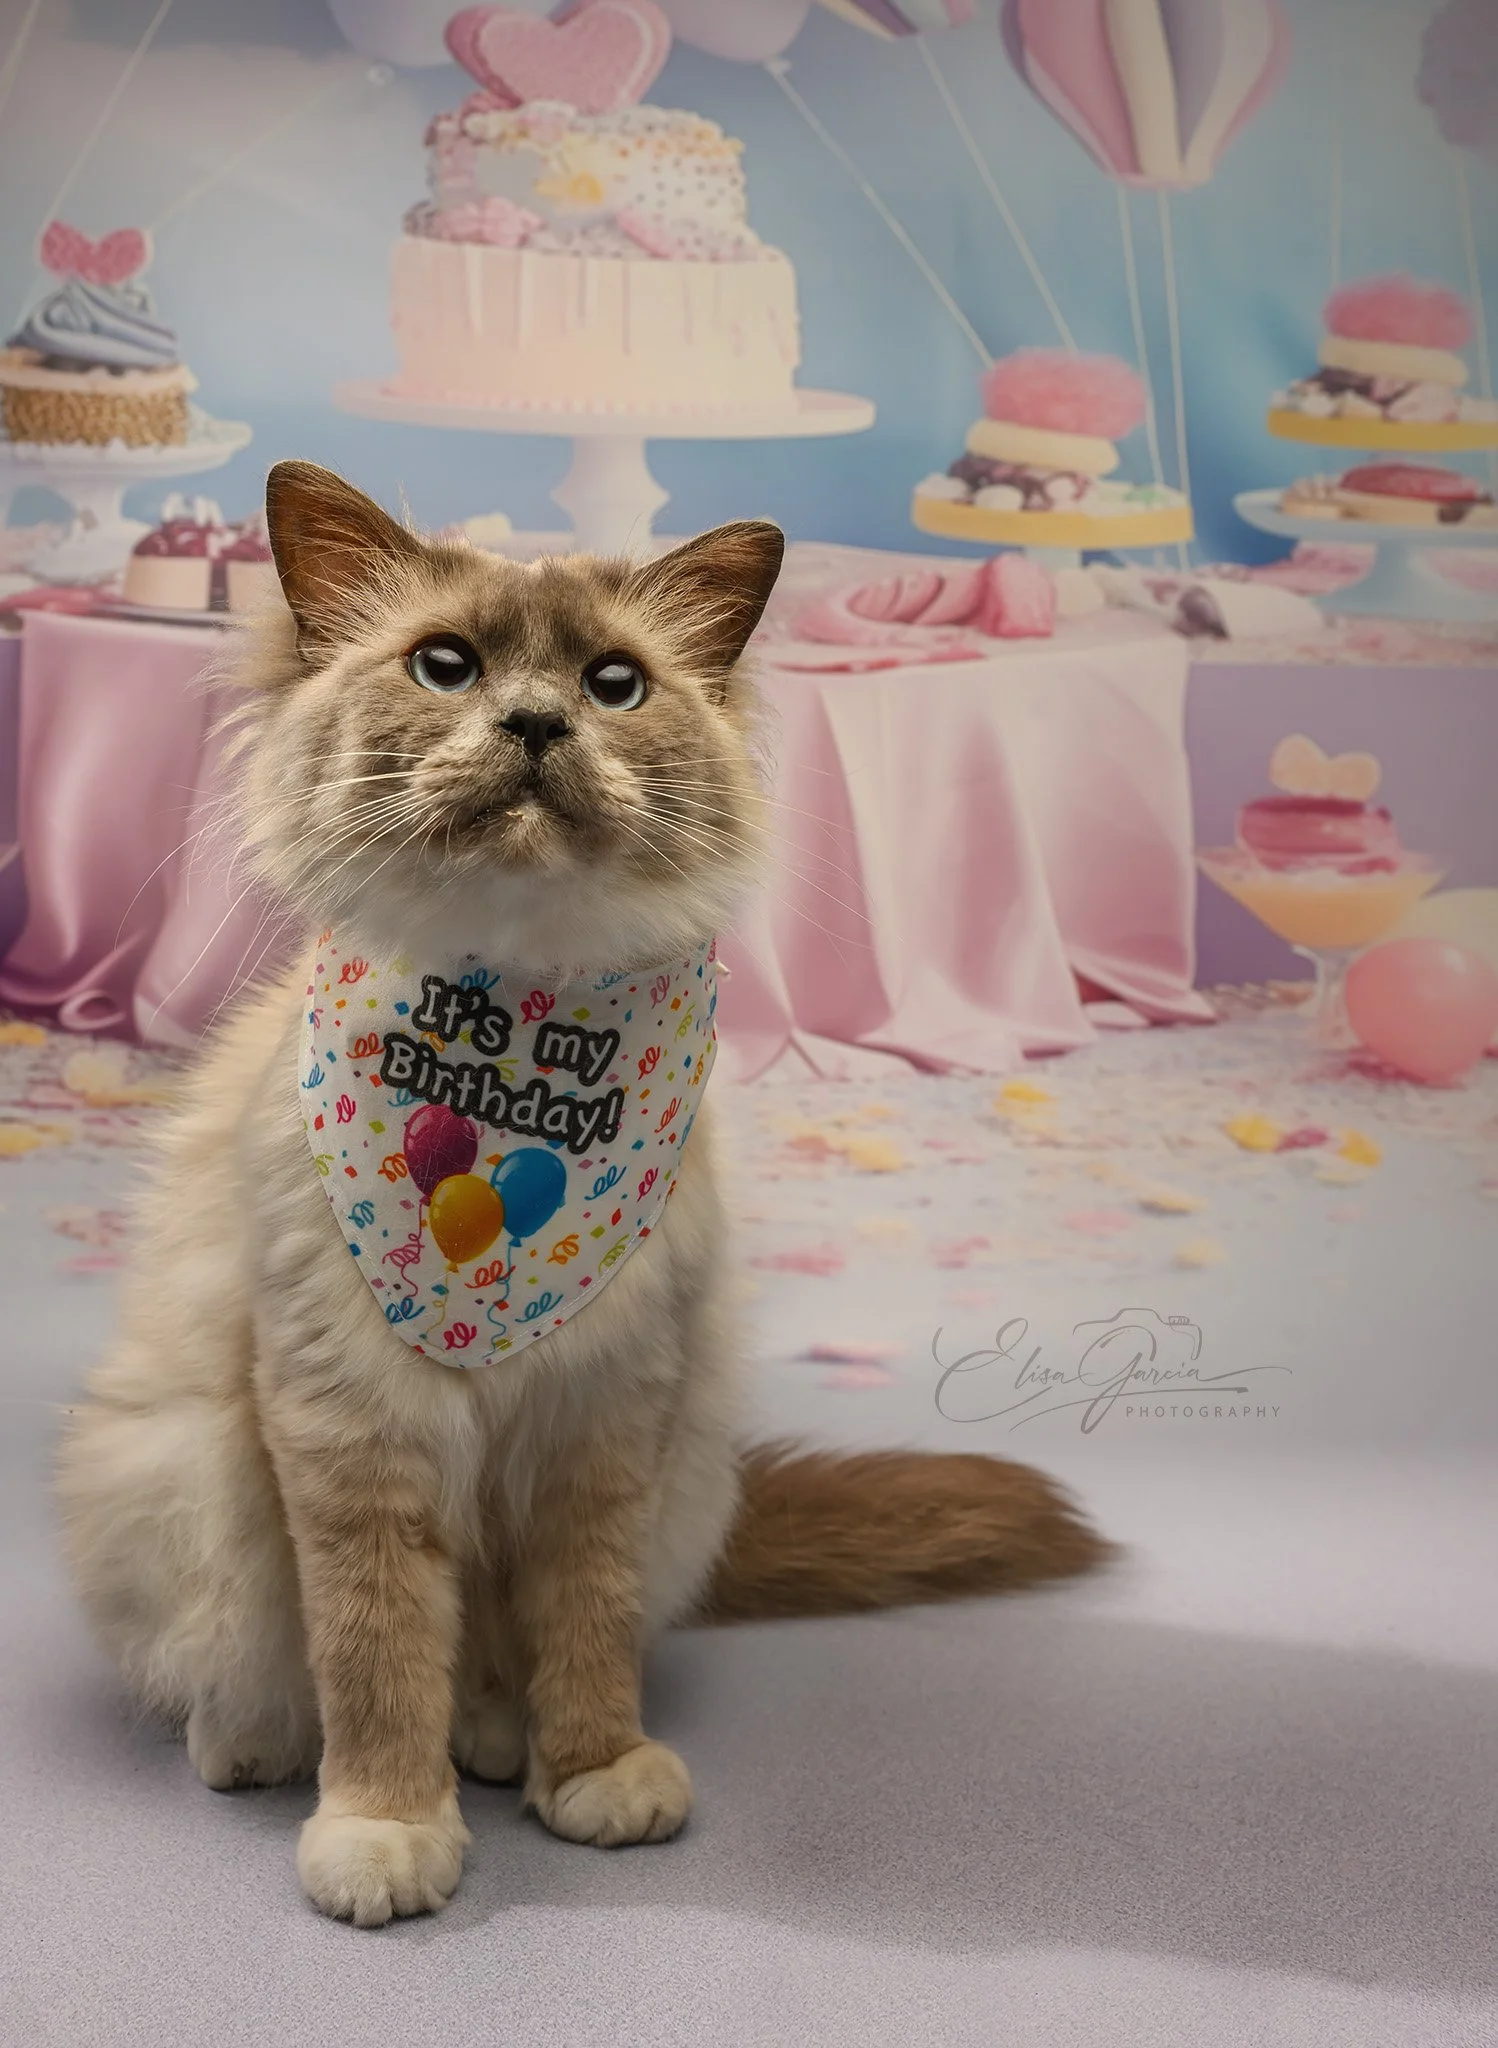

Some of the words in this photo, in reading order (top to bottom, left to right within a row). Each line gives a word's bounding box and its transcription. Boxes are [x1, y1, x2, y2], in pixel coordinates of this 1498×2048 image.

[413, 976, 512, 1055] It's
[535, 1023, 619, 1085] my
[381, 1034, 624, 1153] Birthday!
